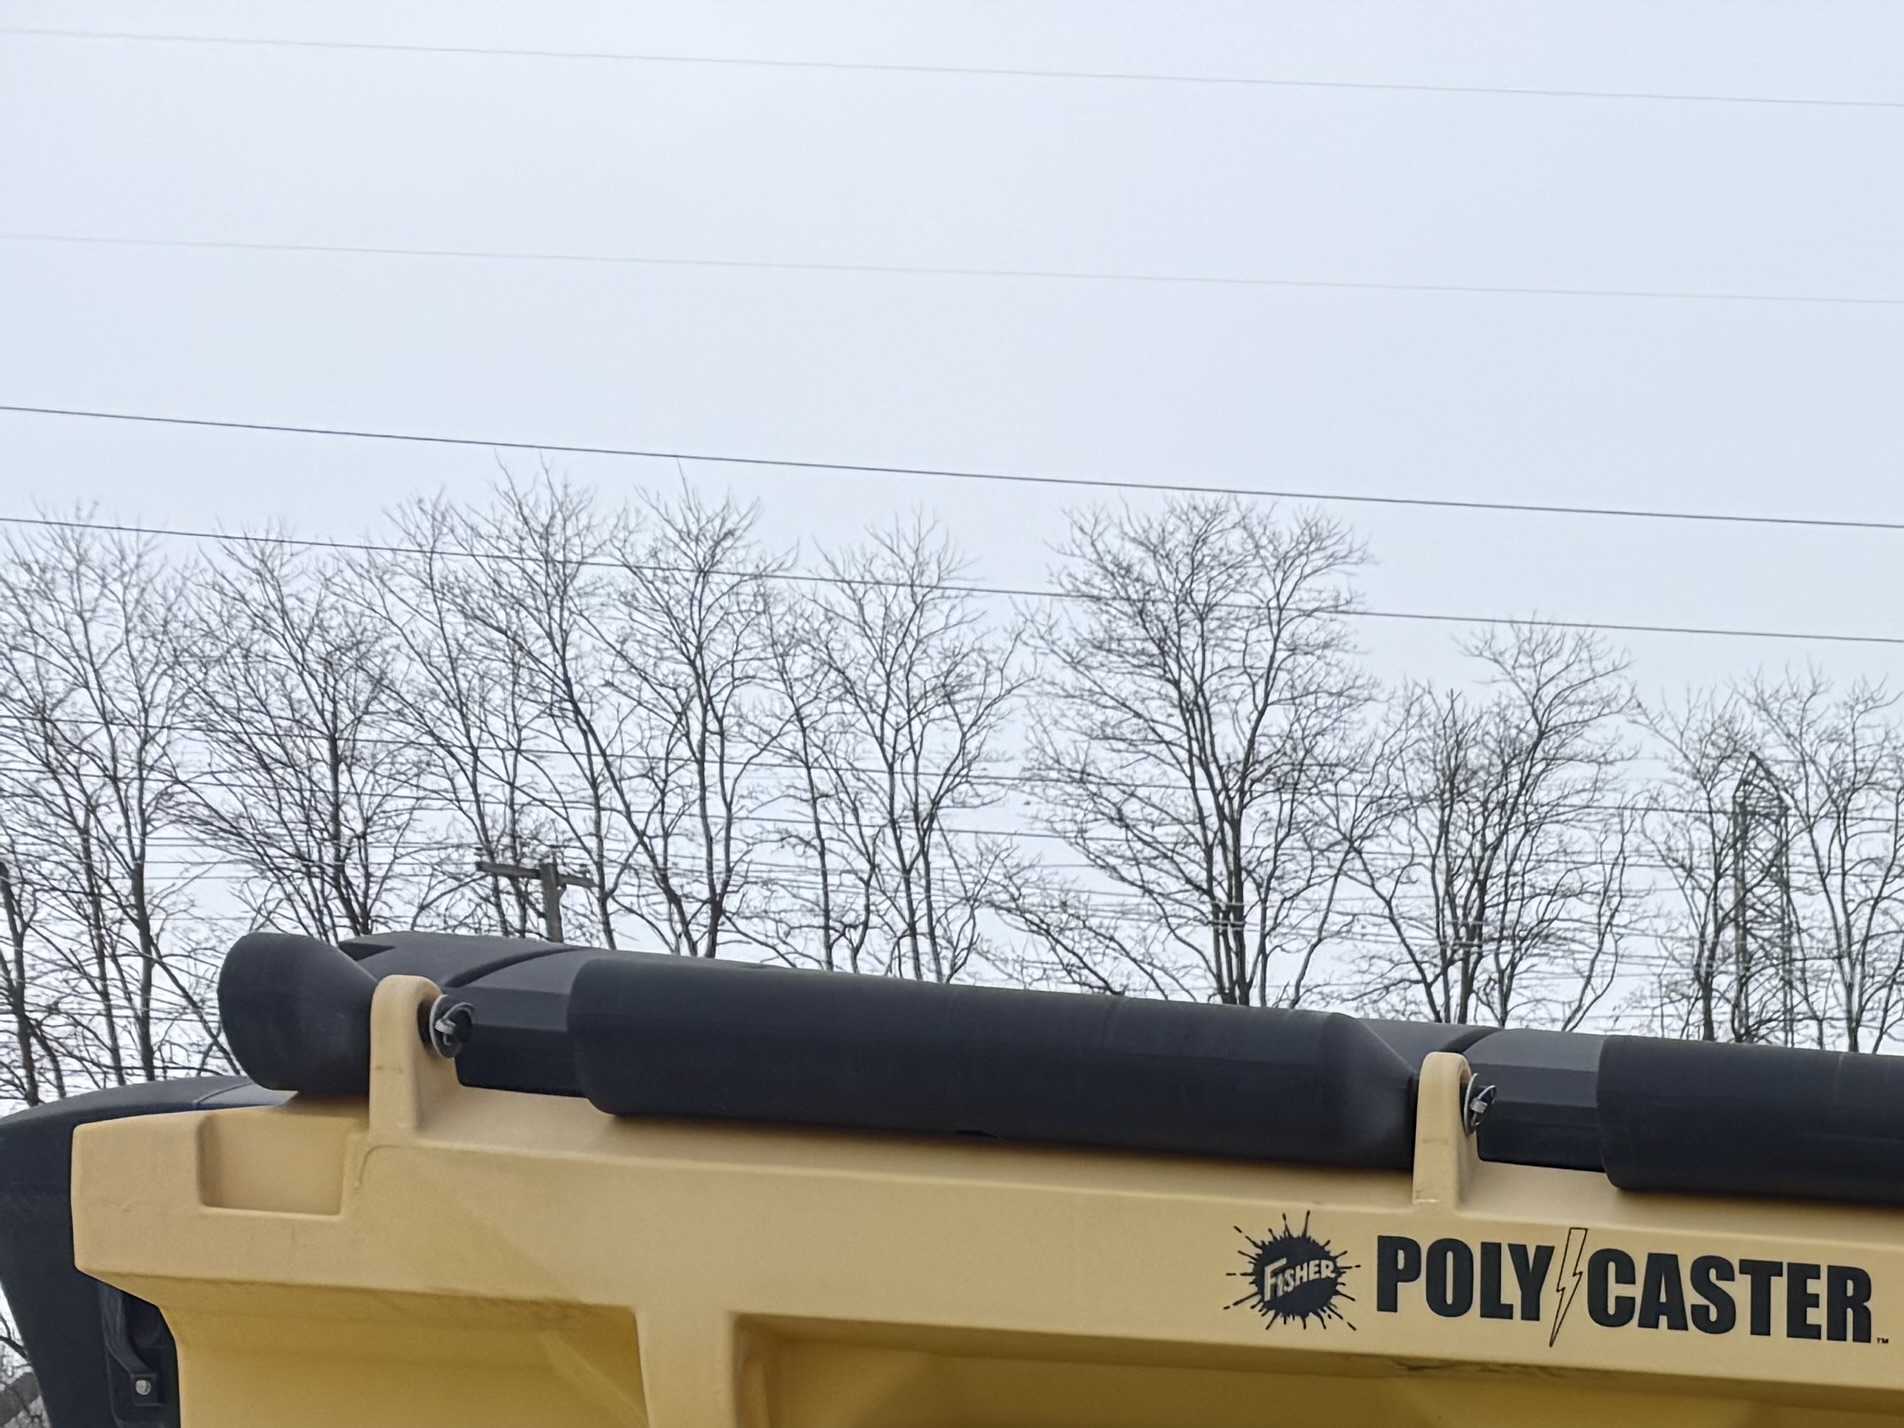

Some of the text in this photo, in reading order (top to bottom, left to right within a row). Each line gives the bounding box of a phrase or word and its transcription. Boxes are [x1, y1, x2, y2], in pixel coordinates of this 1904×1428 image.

[1264, 1257, 1336, 1302] FISHER
[1376, 1233, 1555, 1322] POLY
[1586, 1246, 1873, 1344] CASTER
